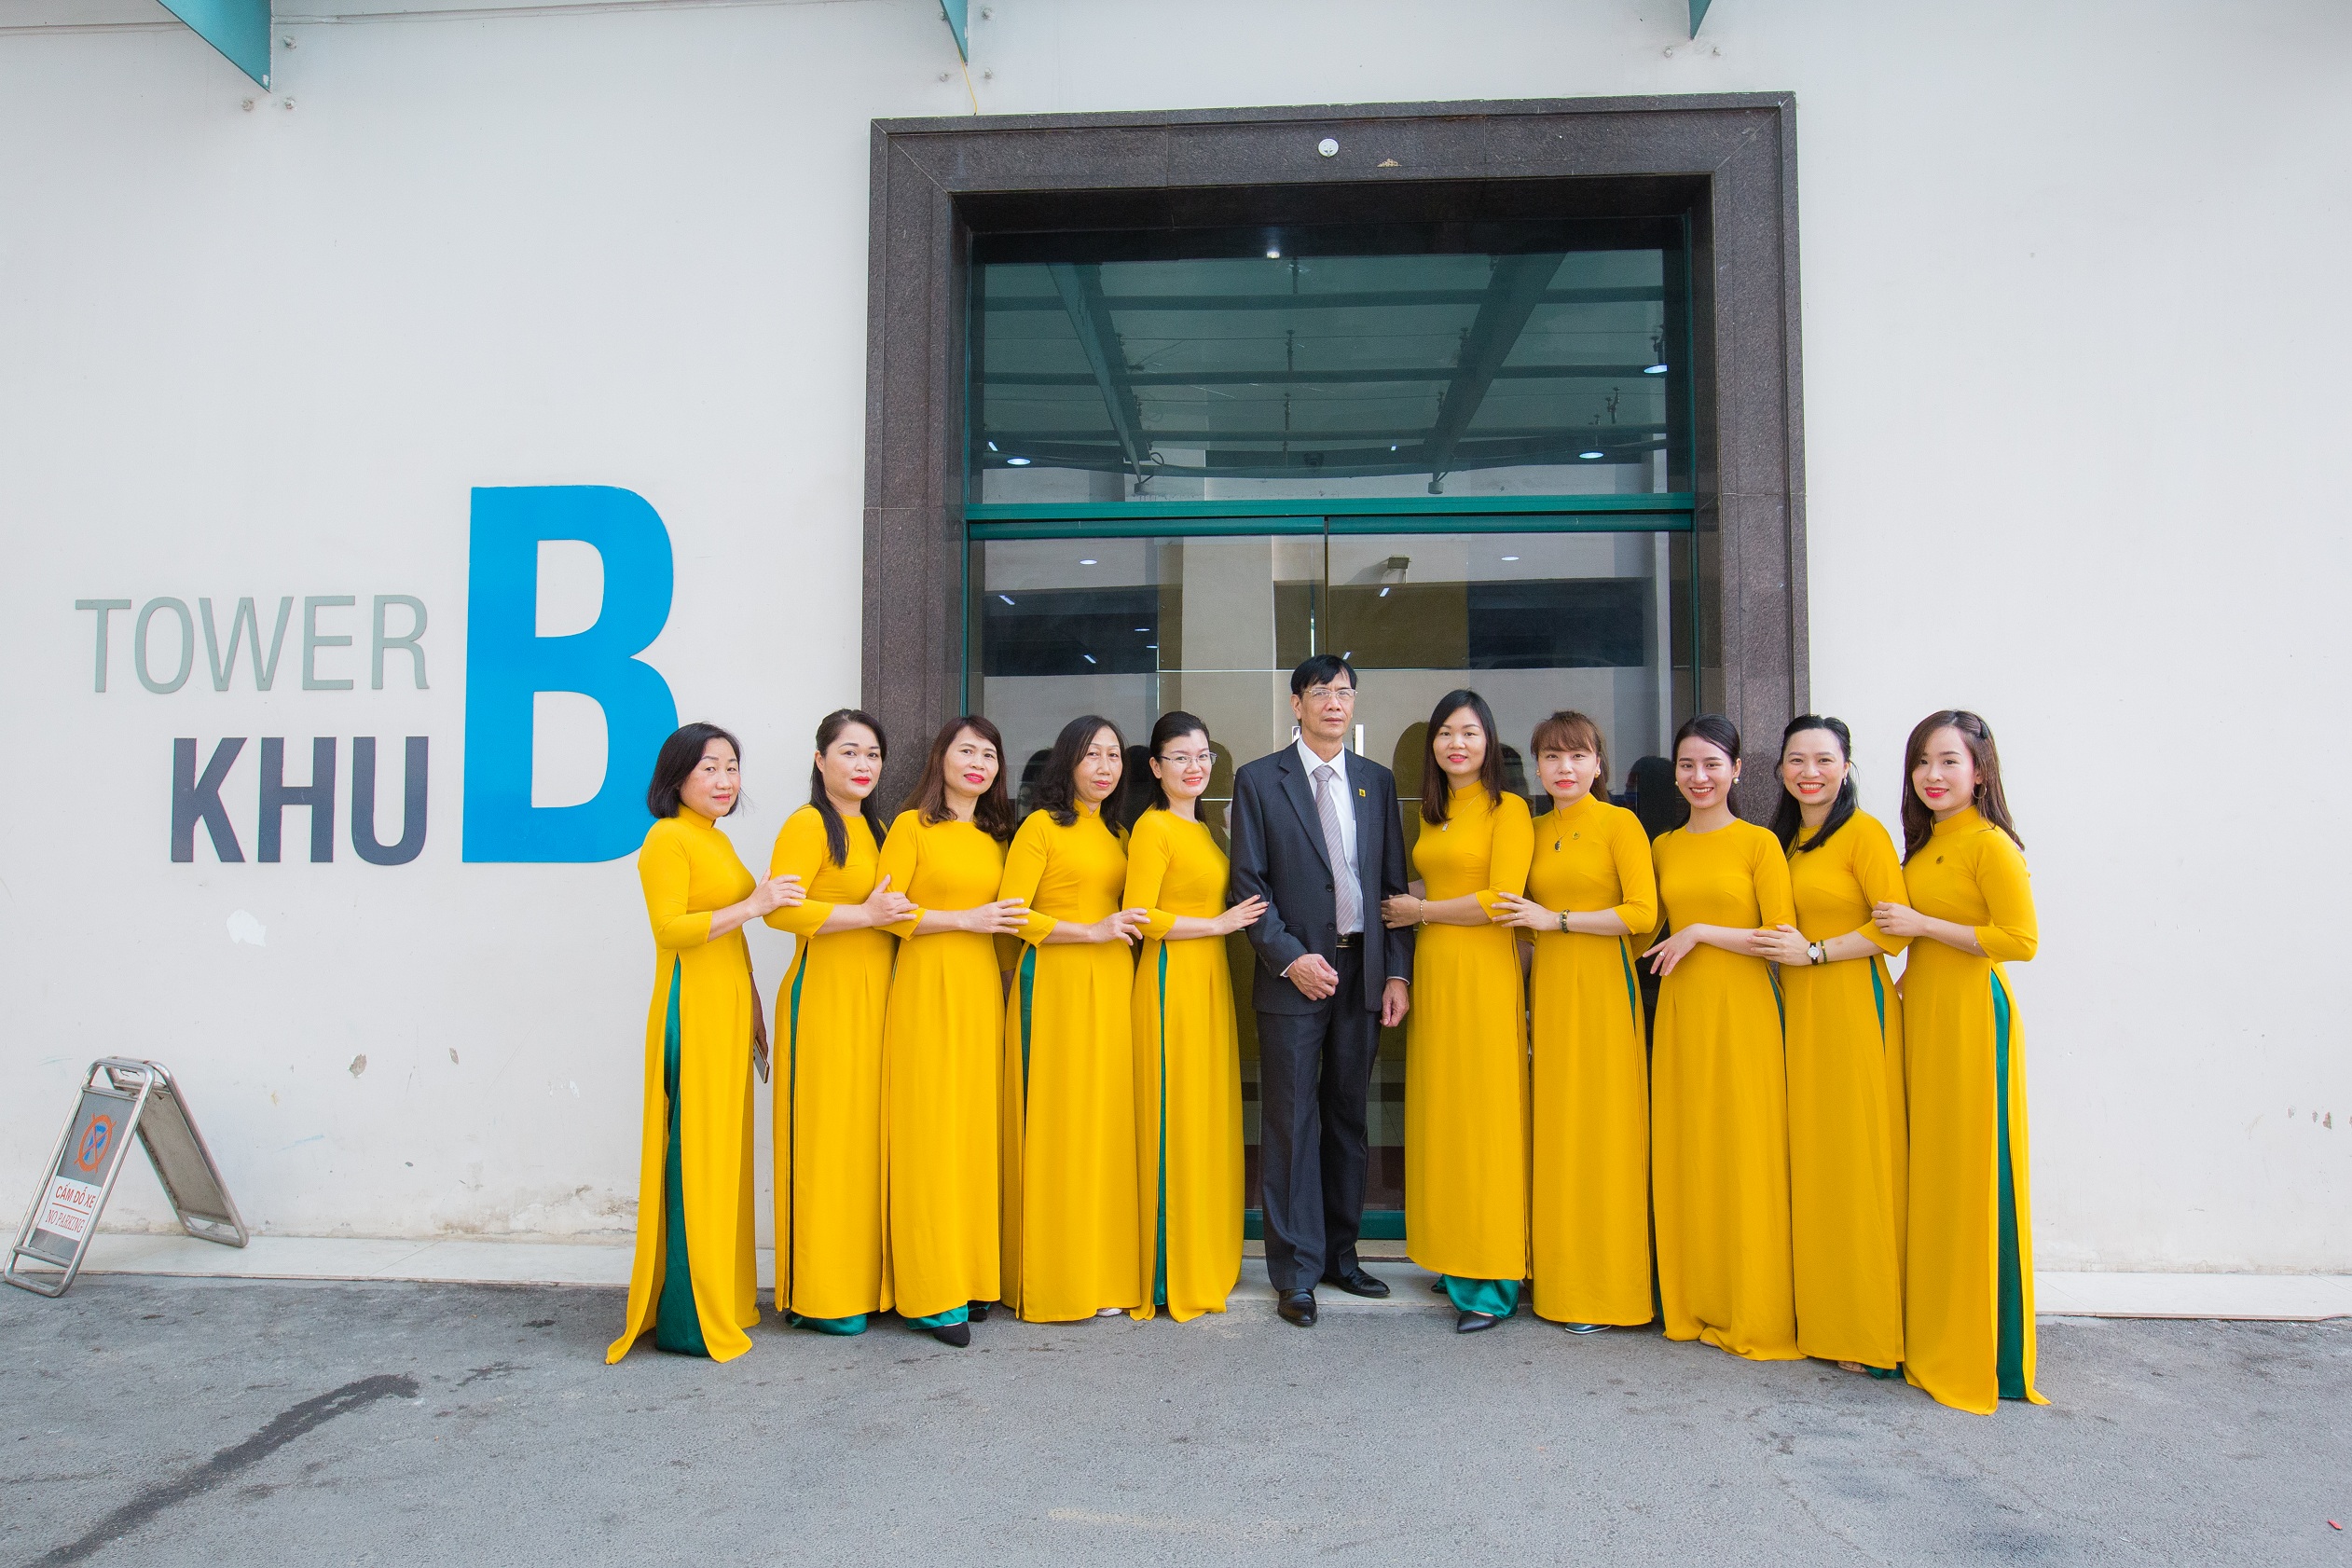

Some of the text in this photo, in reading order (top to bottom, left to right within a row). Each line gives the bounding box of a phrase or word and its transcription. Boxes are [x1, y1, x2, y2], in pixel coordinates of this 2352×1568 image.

[75, 594, 430, 695] TOWER
[462, 486, 679, 863] B
[171, 736, 429, 866] KHU
[46, 1209, 86, 1233] NO PARKING
[56, 1182, 75, 1202] CẤM
[84, 1194, 97, 1208] XE
